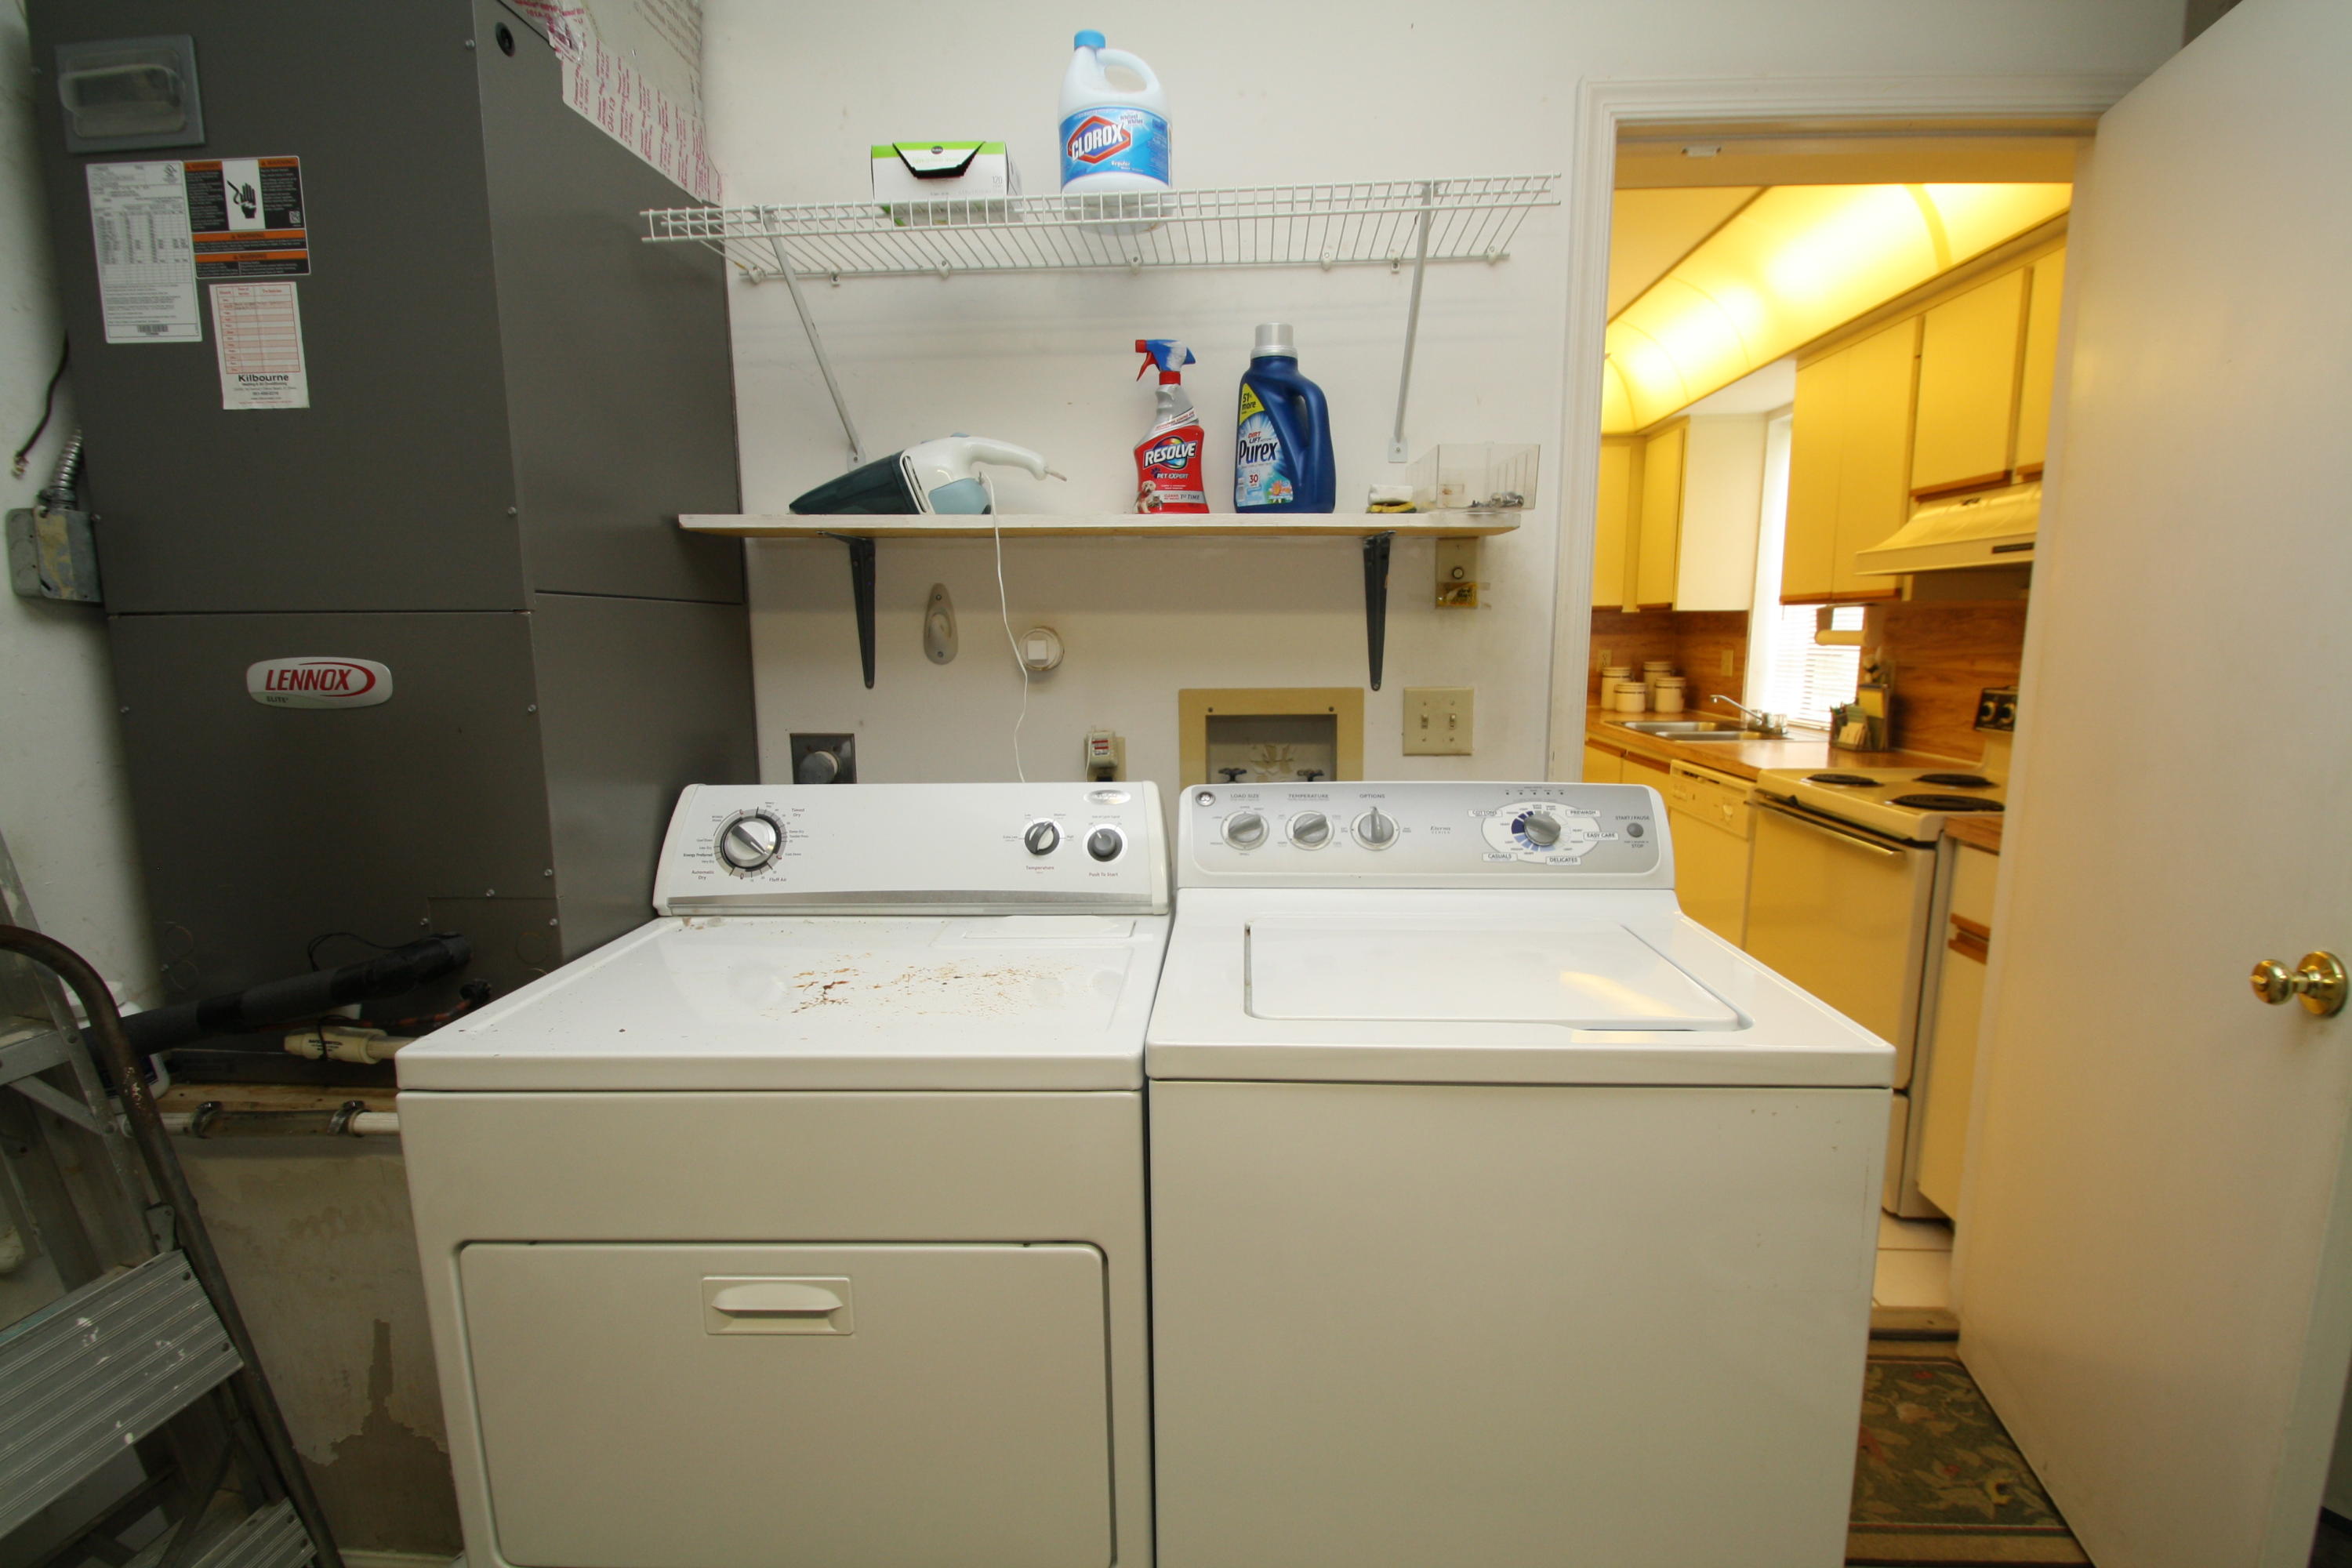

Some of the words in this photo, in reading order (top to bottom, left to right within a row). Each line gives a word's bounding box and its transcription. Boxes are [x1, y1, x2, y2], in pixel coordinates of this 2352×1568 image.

[1072, 123, 1123, 162] CLOROX
[1145, 441, 1197, 467] RESOLVE
[1239, 440, 1278, 465] Purex
[1249, 474, 1258, 484] 30
[265, 669, 352, 691] LENNOX
